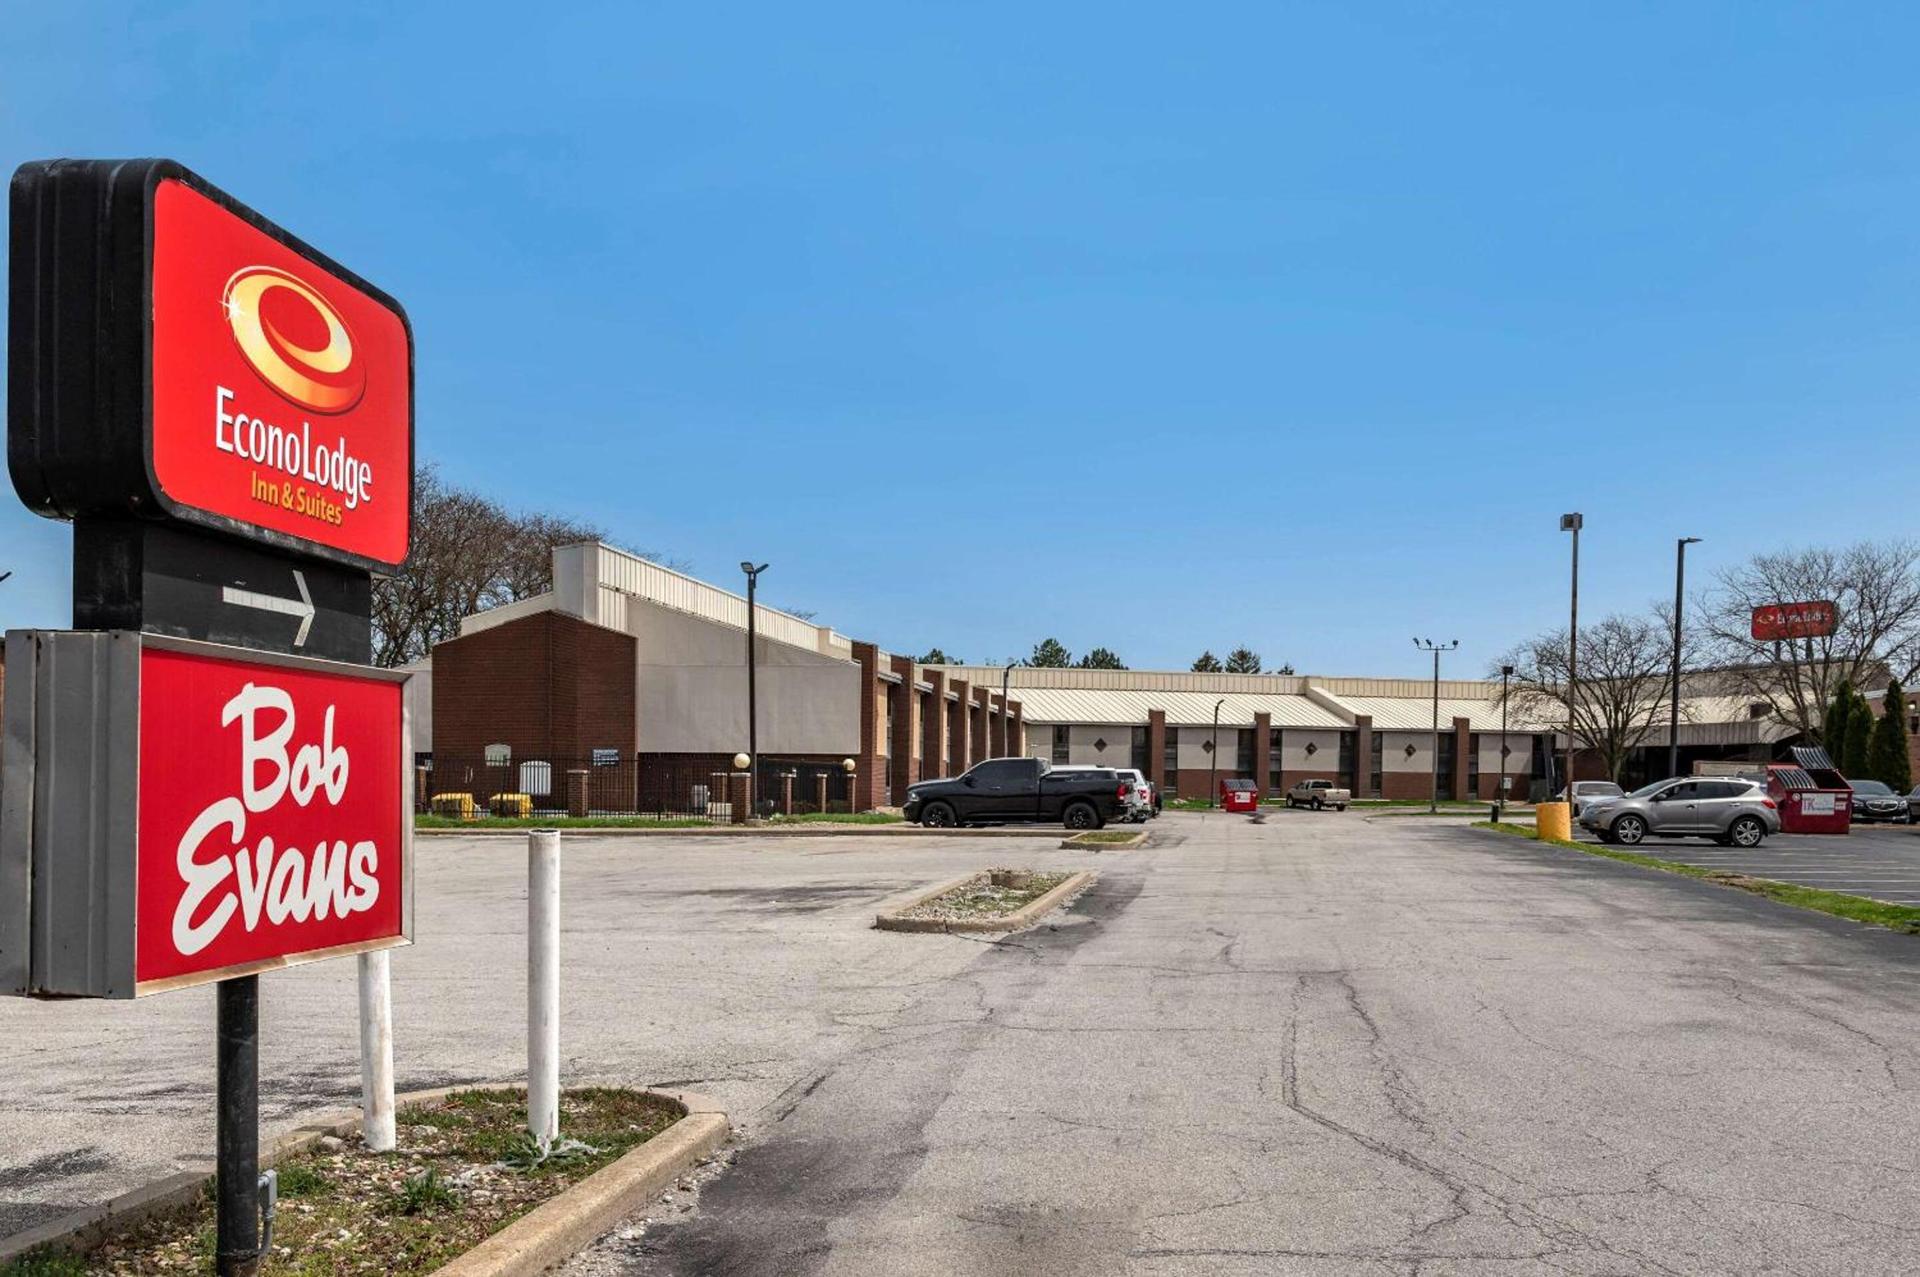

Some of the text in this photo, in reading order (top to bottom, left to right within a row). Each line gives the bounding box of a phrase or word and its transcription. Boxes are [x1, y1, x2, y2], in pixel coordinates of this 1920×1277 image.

[252, 471, 342, 524] Inn & Suites
[222, 682, 349, 812] Bob
[172, 797, 379, 955] Evans
